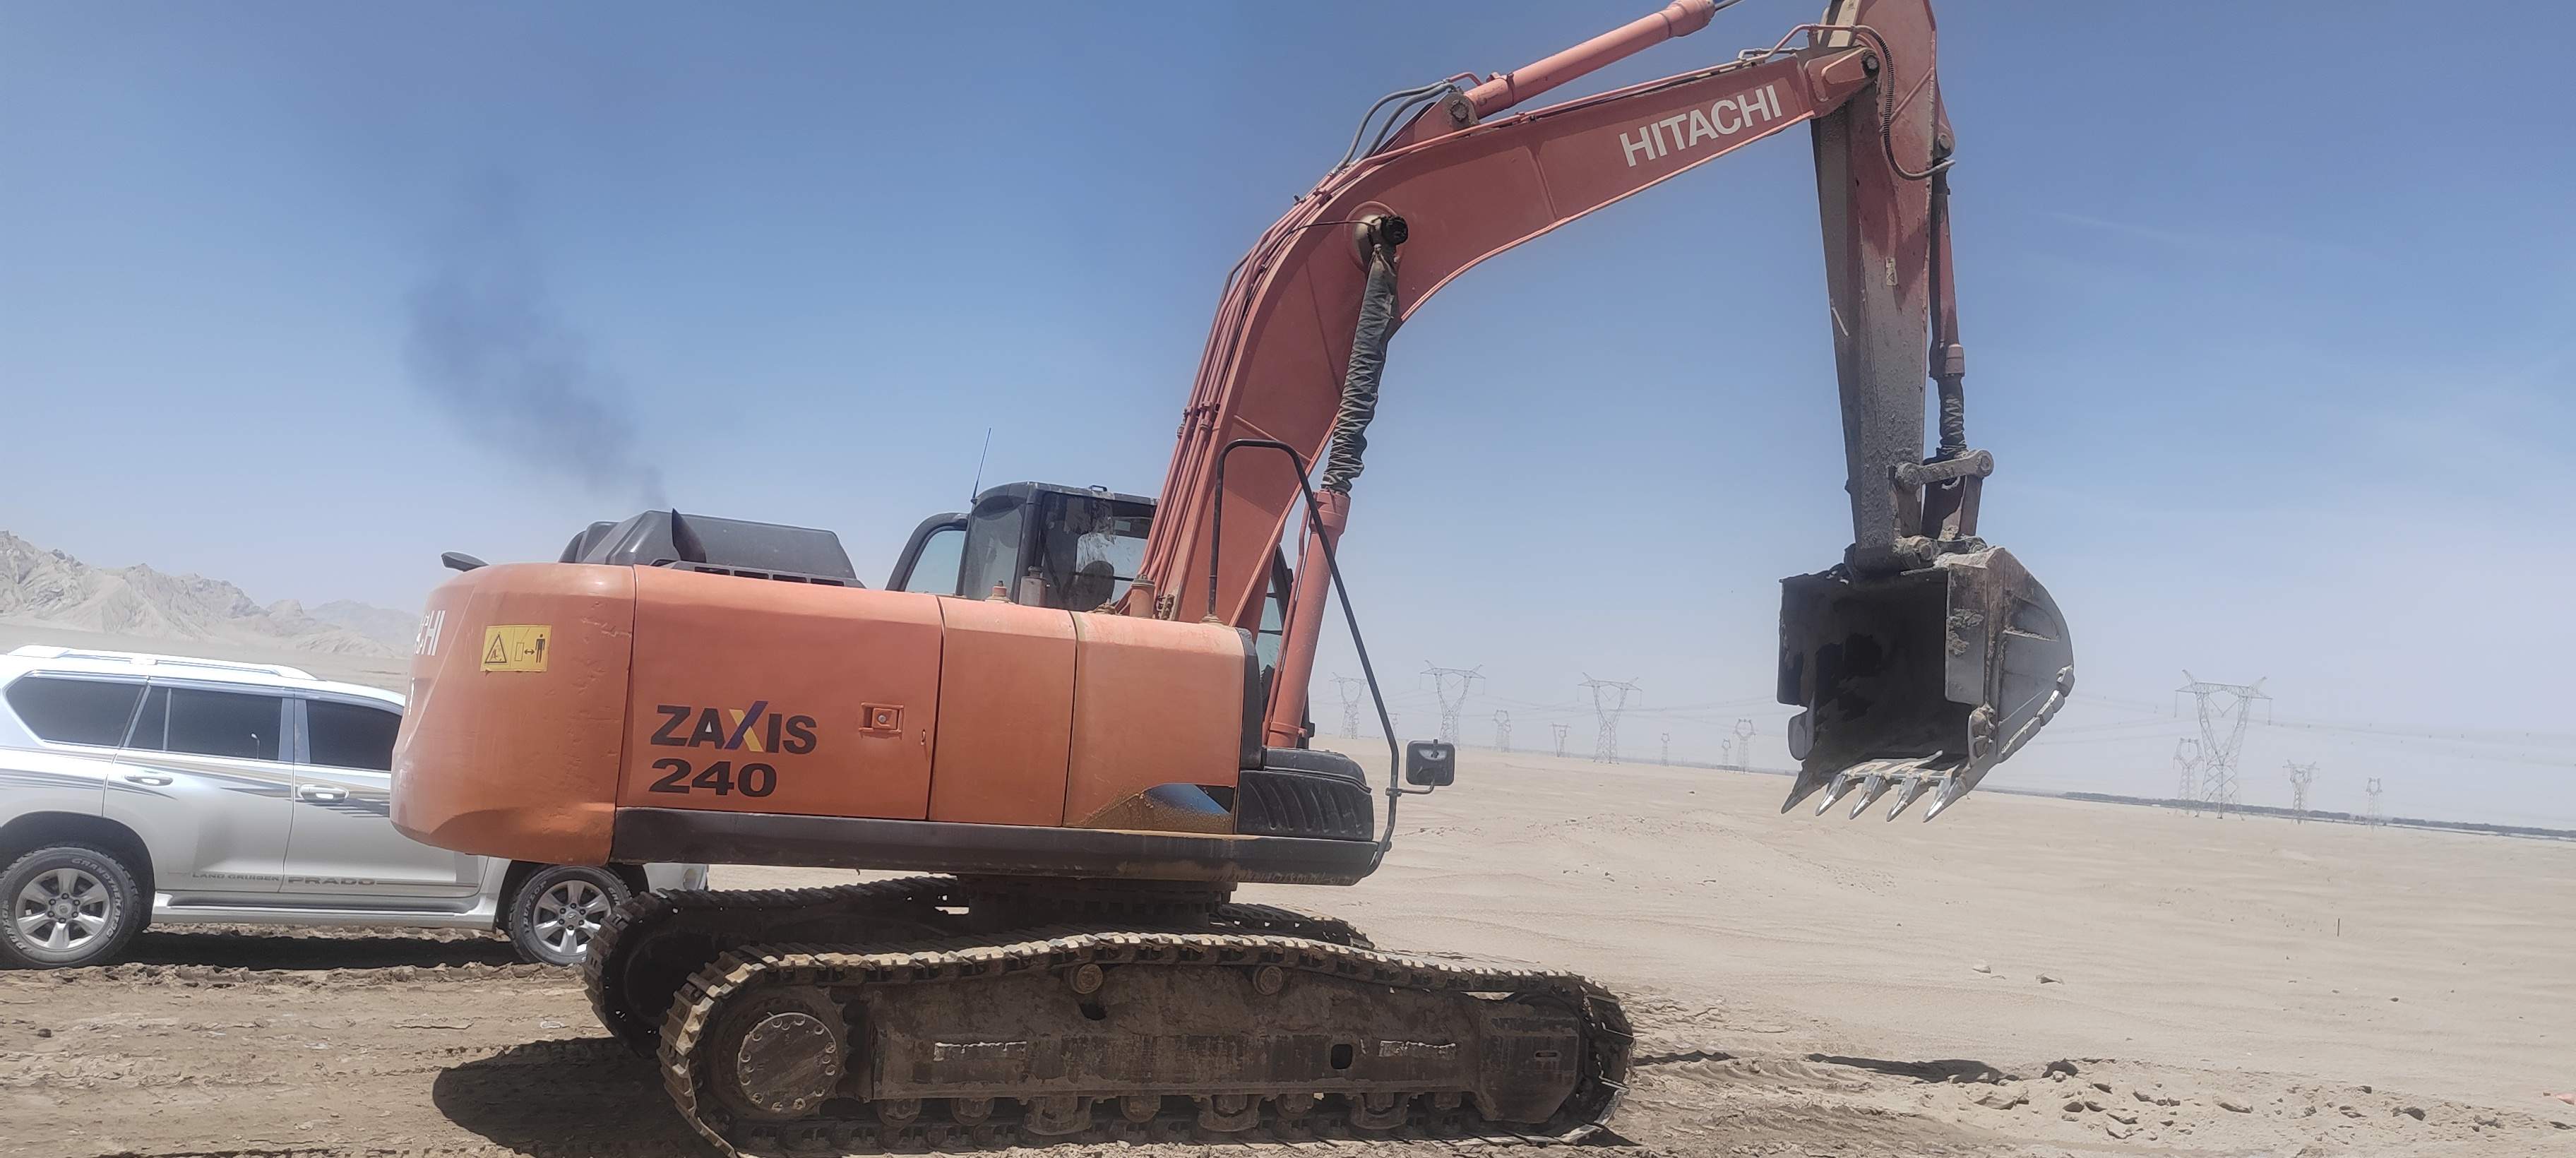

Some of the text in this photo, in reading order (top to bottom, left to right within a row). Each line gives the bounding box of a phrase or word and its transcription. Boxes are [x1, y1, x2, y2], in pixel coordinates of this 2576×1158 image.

[1619, 84, 1782, 167] HITACHI
[415, 609, 446, 657] CHI
[650, 700, 818, 755] ZAXIS
[648, 758, 777, 798] 240
[71, 858, 122, 907] GRANDTREK
[287, 876, 376, 885] PRADO
